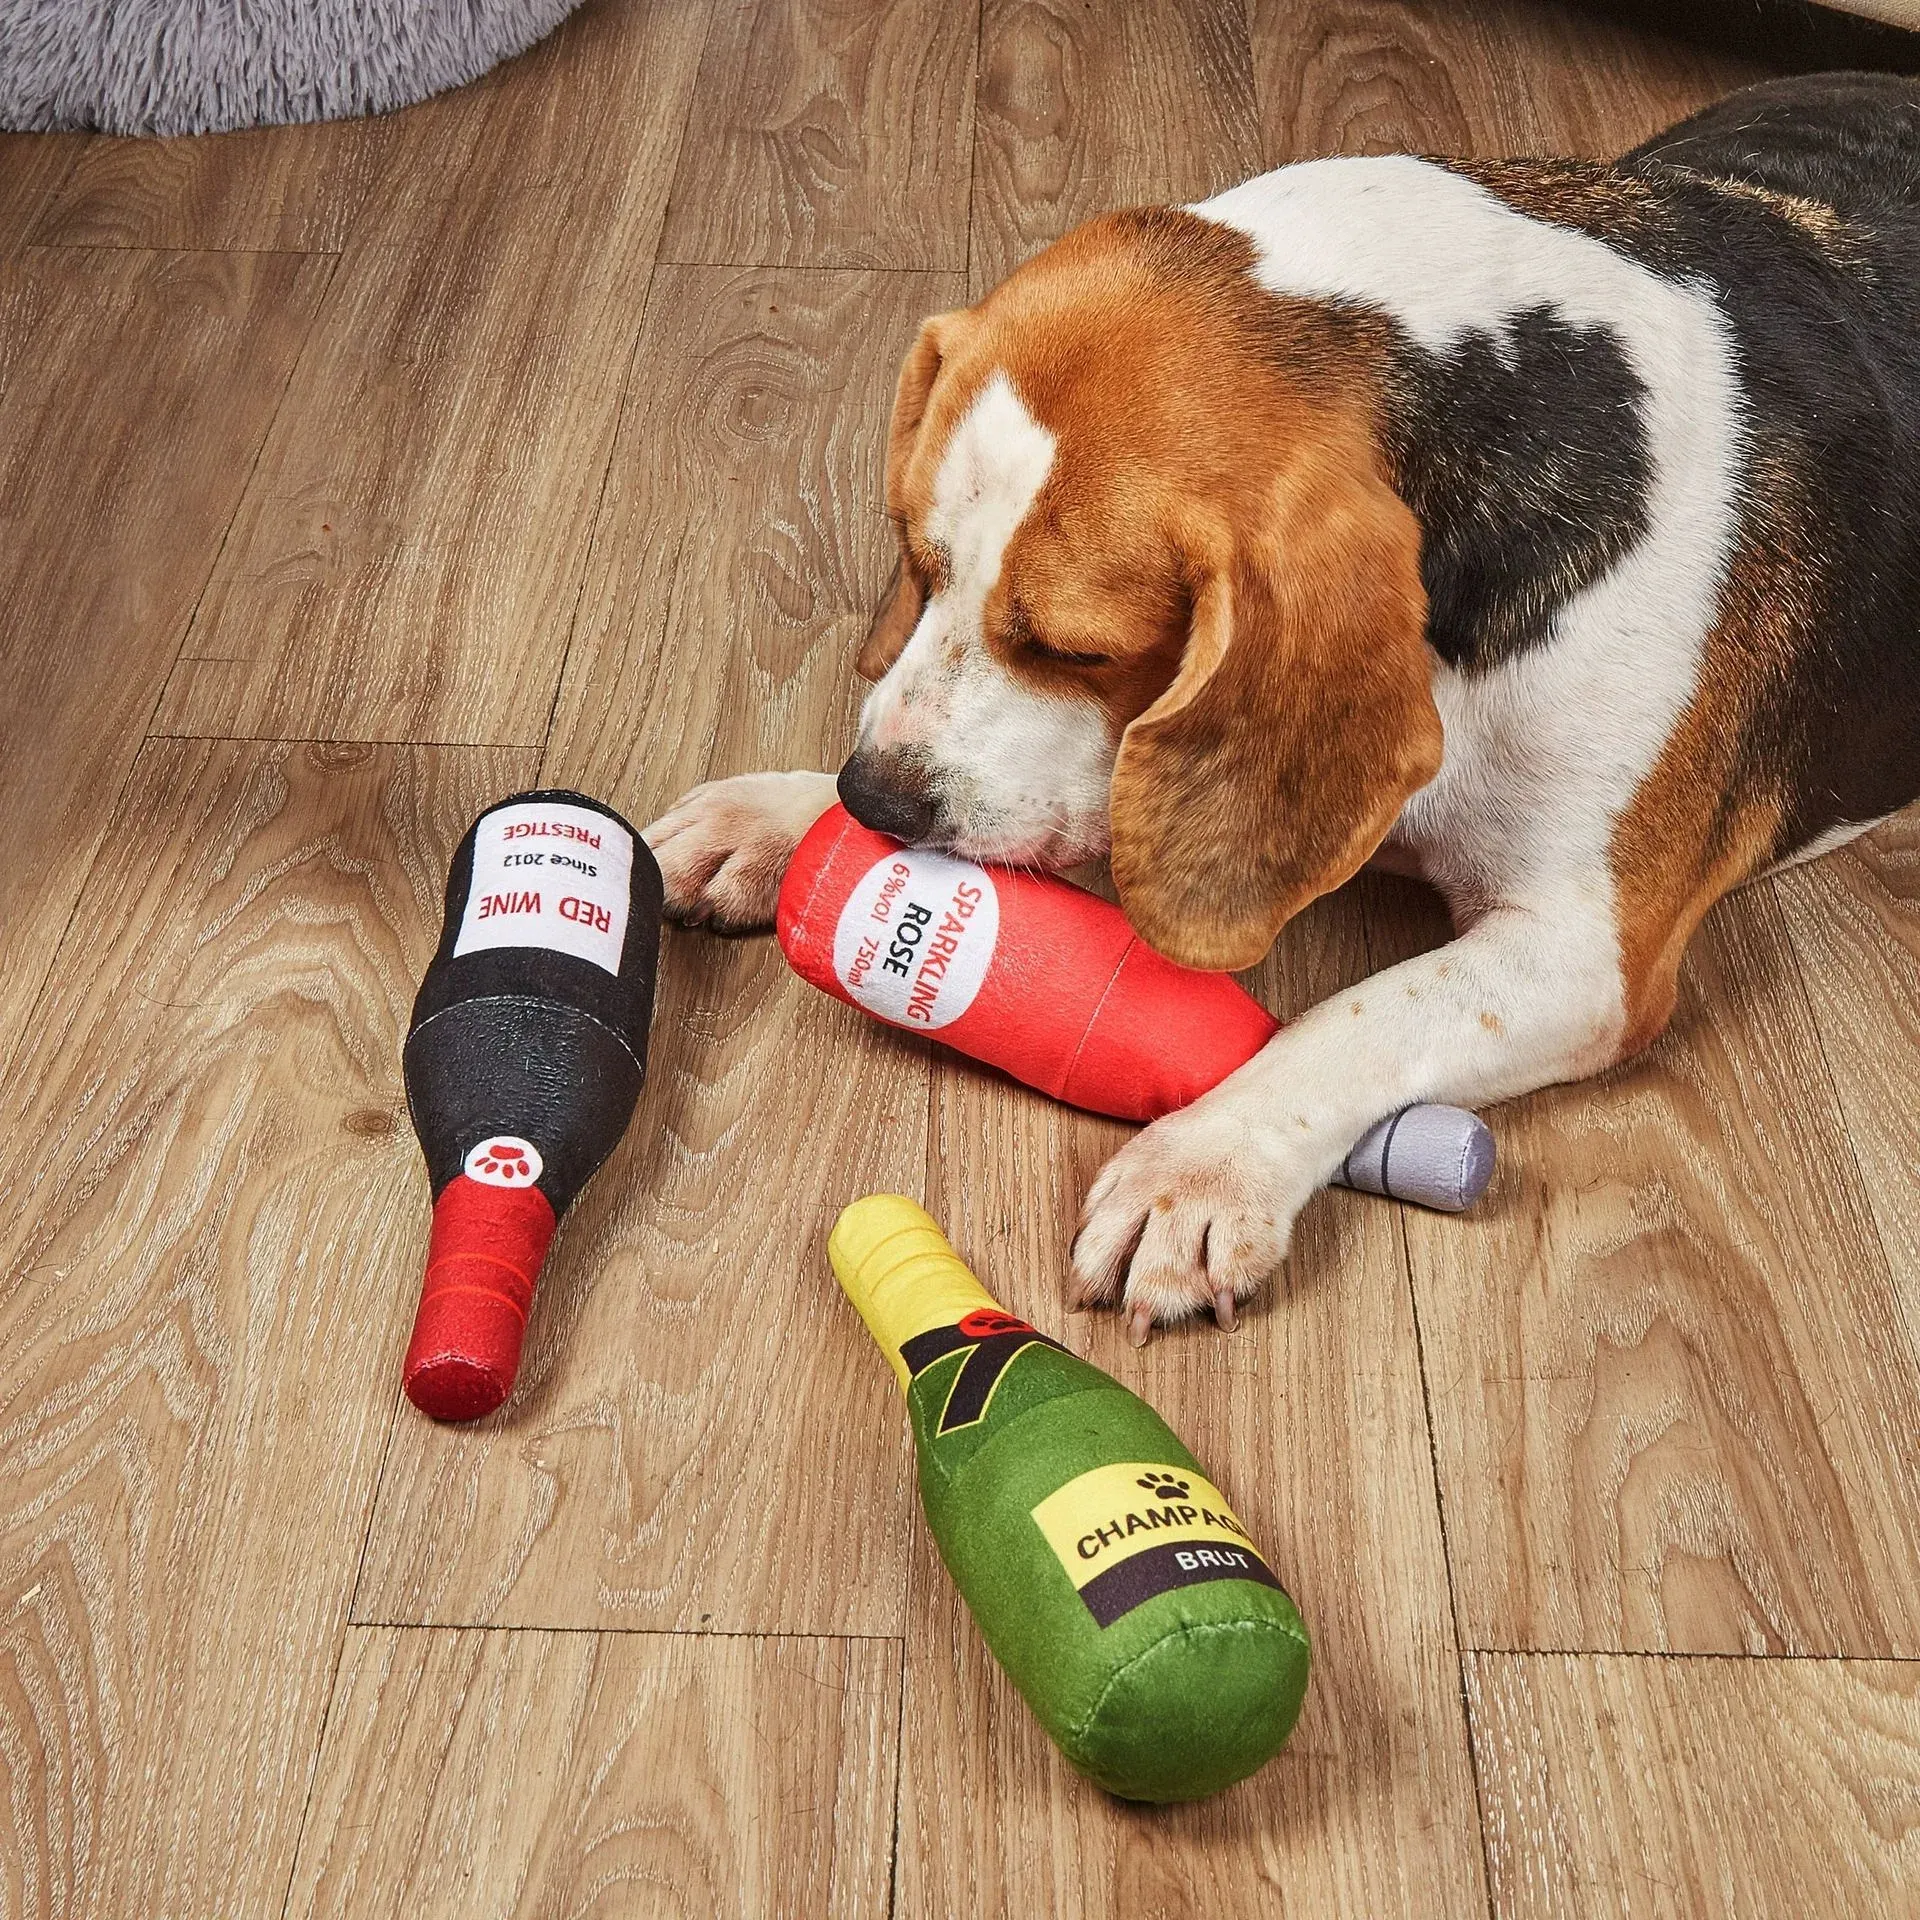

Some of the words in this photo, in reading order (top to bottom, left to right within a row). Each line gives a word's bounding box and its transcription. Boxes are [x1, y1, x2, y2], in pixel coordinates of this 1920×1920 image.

[503, 821, 602, 850] PRESTIGE
[503, 853, 545, 867] 2012
[549, 853, 598, 877] Since
[477, 891, 541, 920] WINE
[870, 862, 911, 924] 6%vol
[558, 896, 612, 933] RED
[882, 902, 933, 978] ROSE
[907, 881, 982, 1022] SPARKLING
[847, 936, 880, 989] 750ml
[1174, 1550, 1250, 1571] BRUT
